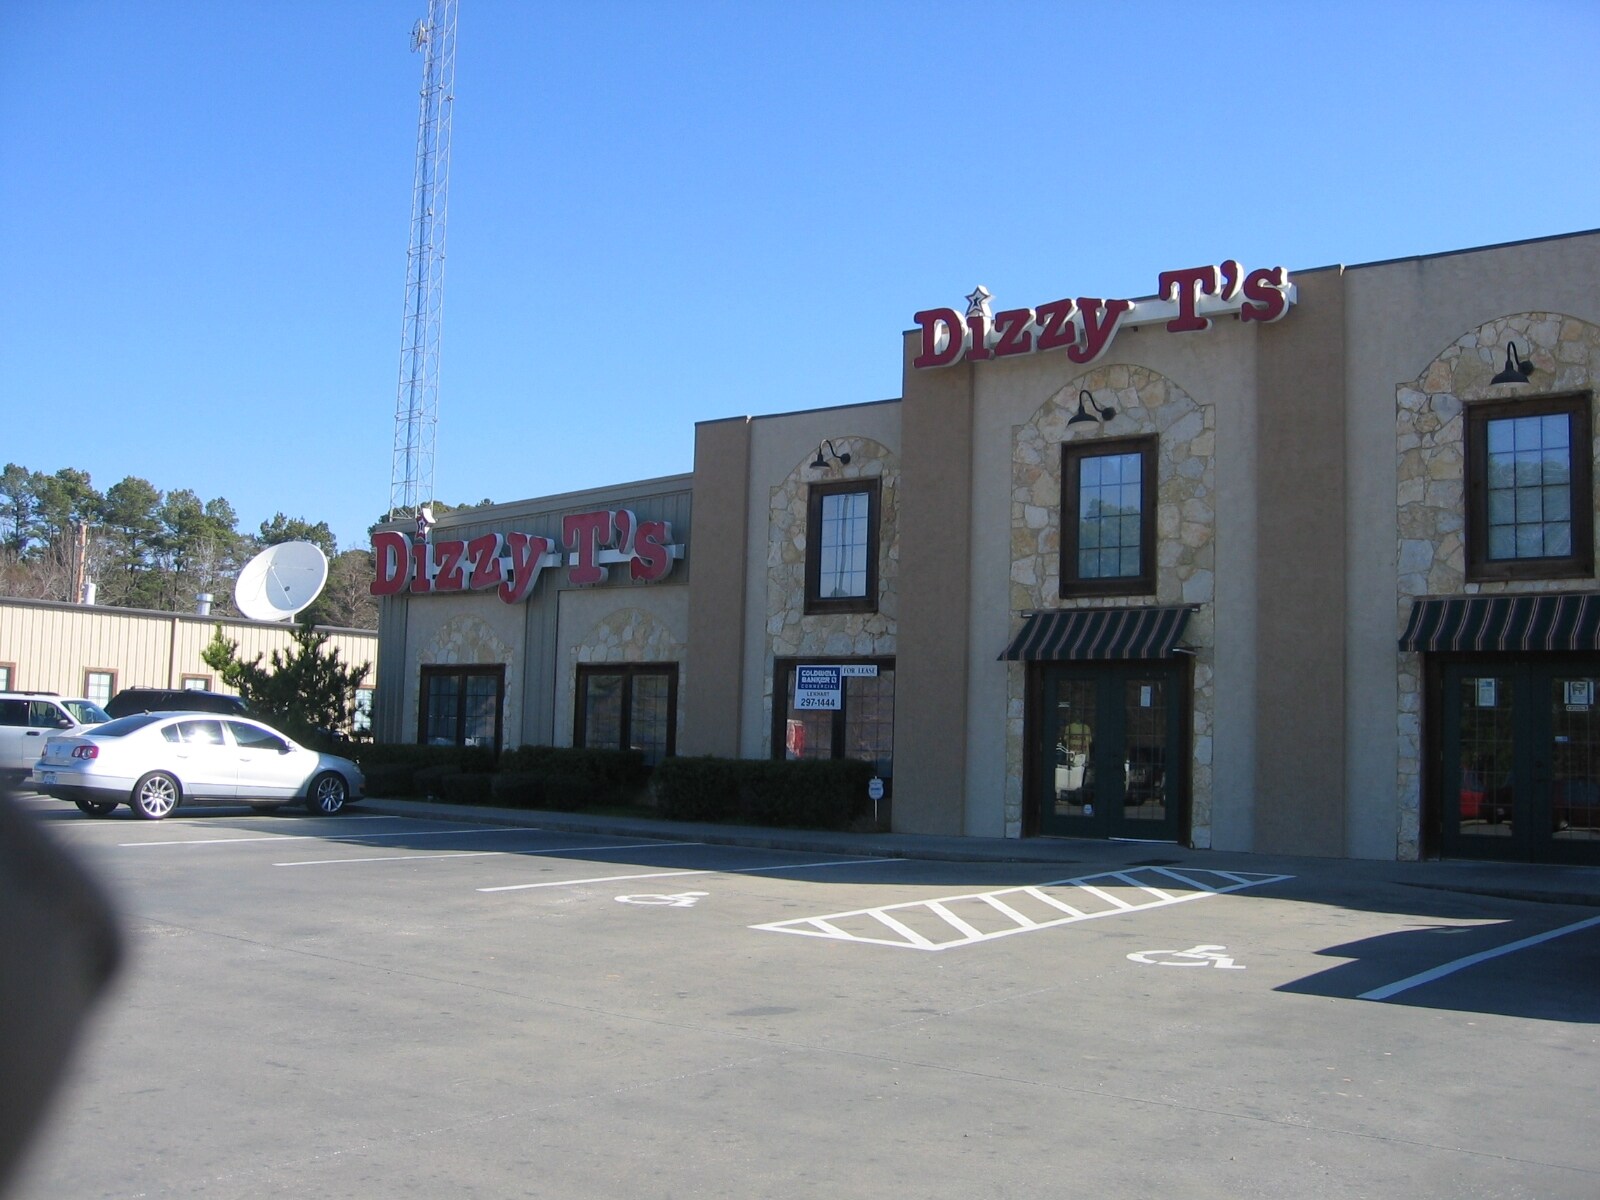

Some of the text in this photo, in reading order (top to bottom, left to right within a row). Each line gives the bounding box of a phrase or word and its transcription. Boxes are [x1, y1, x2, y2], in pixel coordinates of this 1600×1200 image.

[913, 259, 1288, 369] Dizzy T's
[370, 507, 673, 604] Dizzy T's
[800, 698, 835, 707] 297-1444
